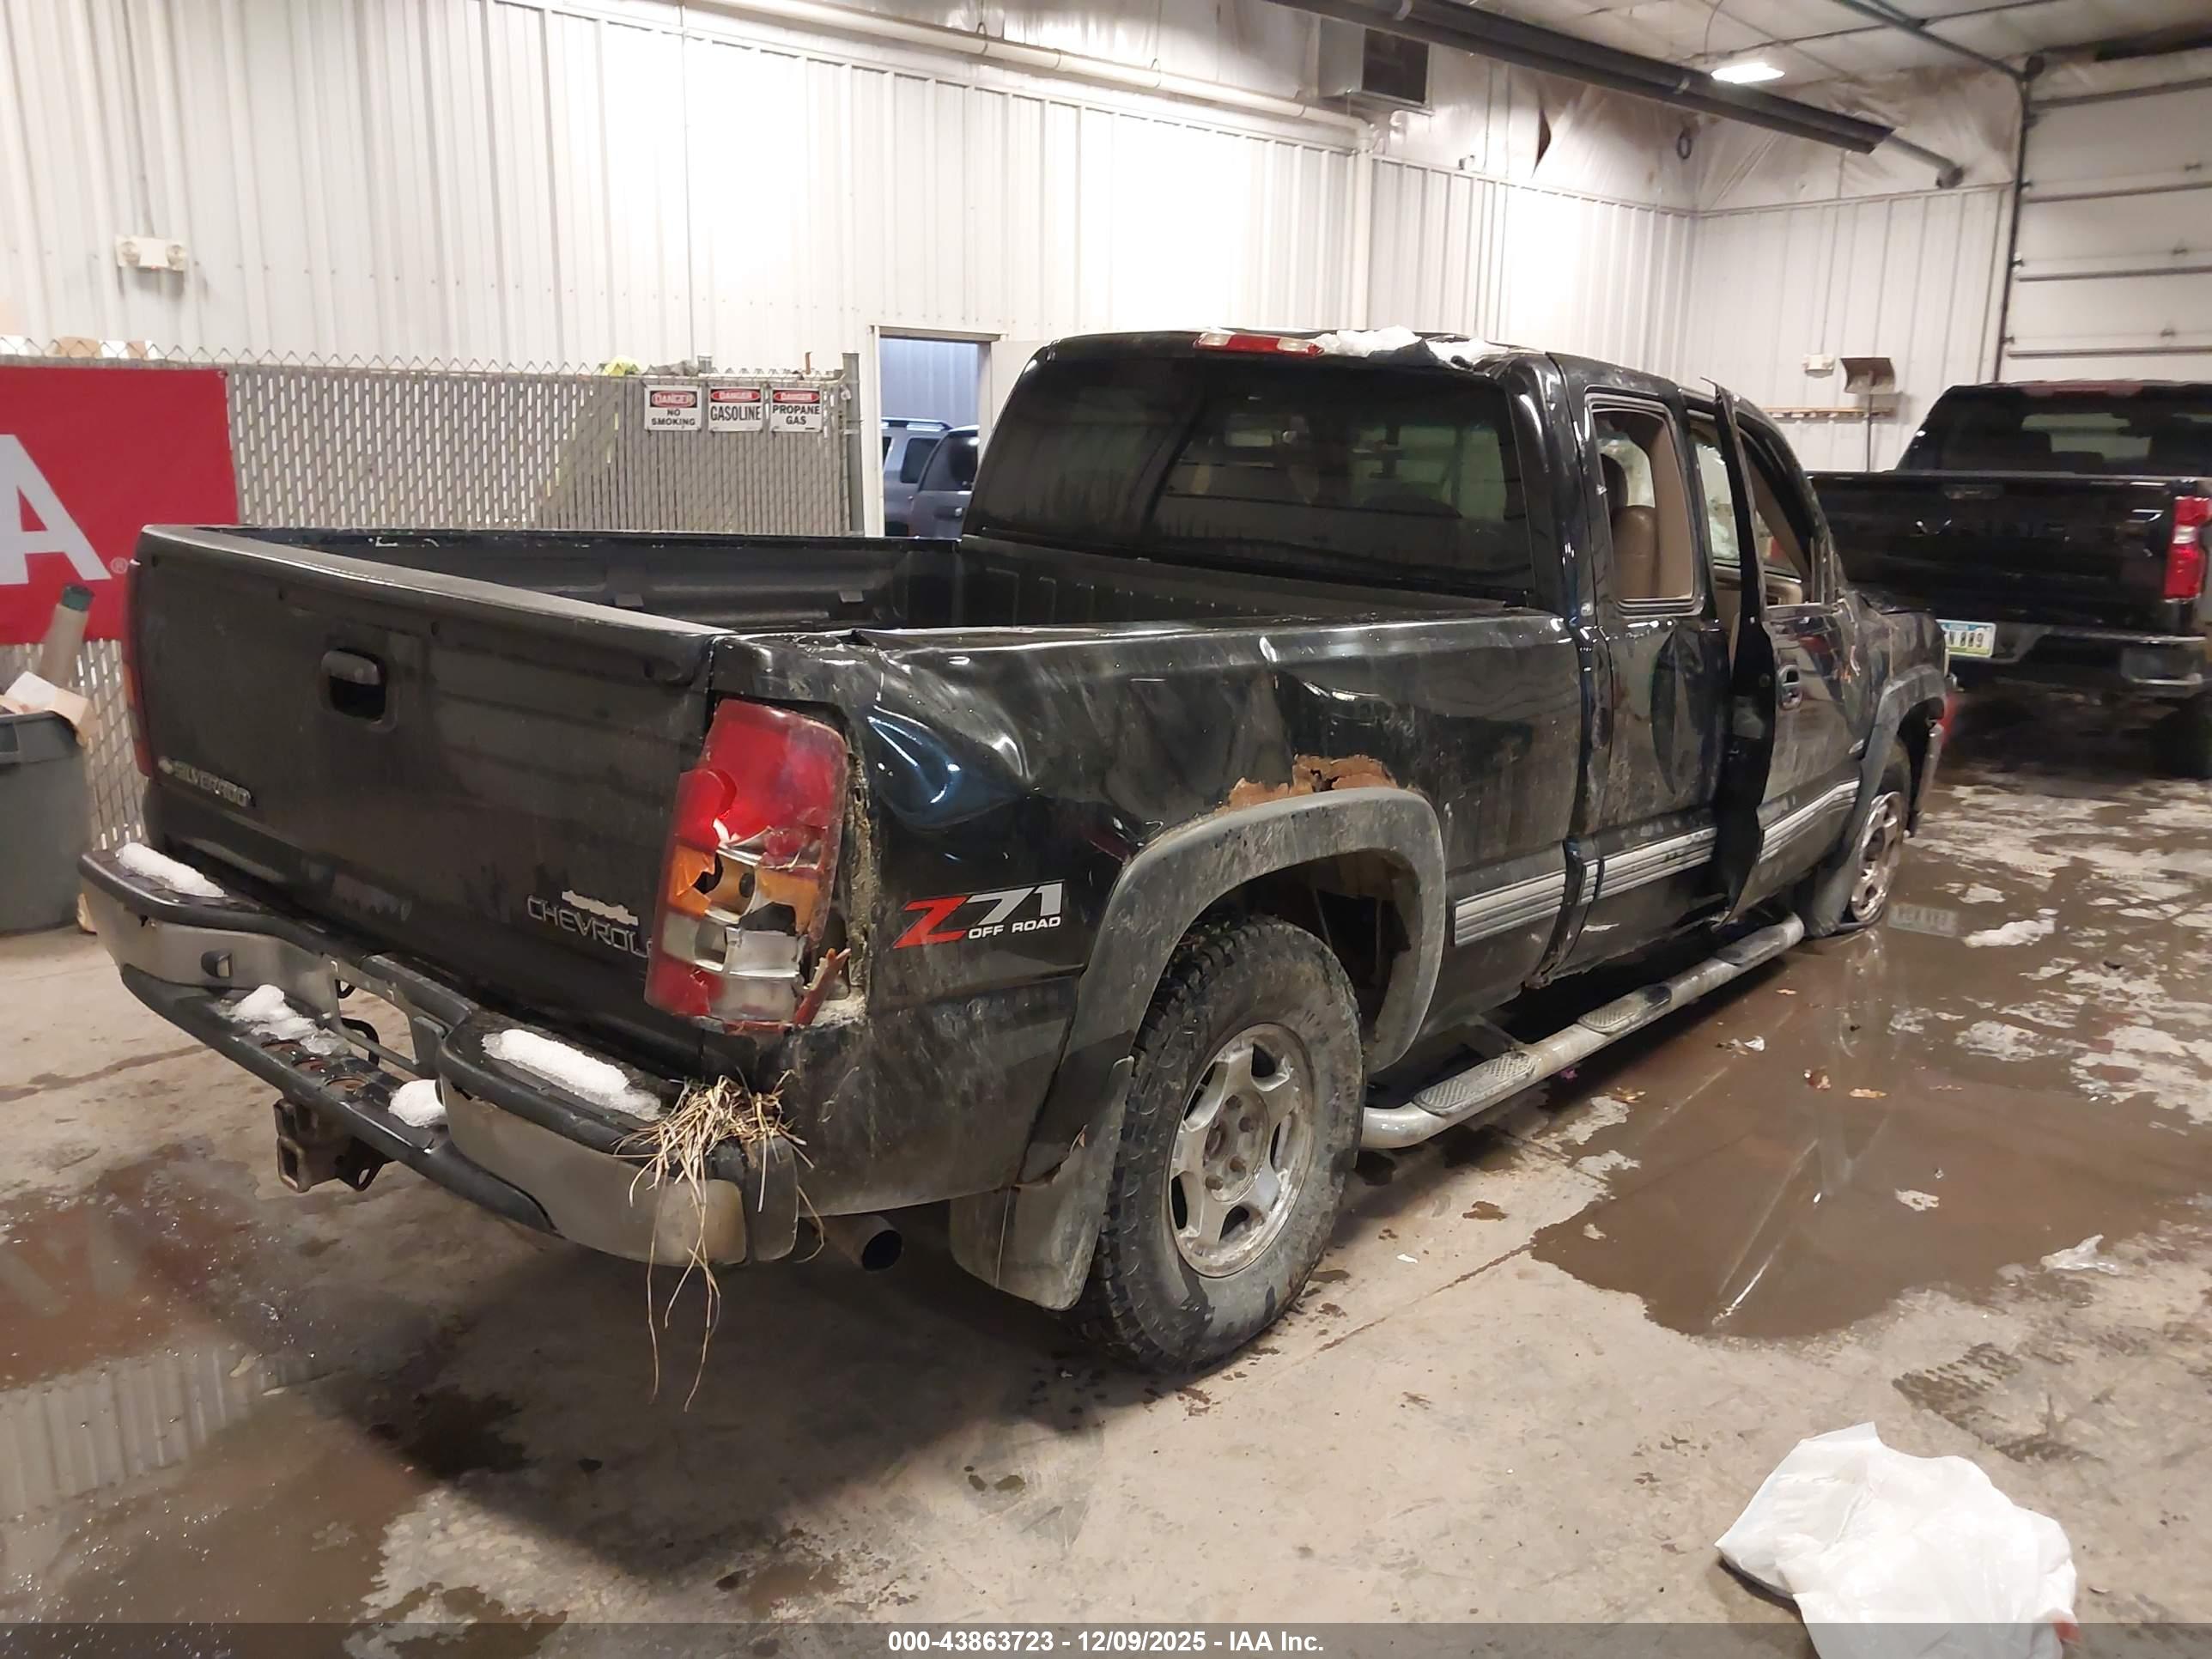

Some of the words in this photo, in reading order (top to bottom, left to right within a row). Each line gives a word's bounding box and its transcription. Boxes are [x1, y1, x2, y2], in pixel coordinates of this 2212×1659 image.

[710, 405, 762, 421] GASOLINE
[773, 404, 821, 415] PROPANE
[786, 416, 807, 425] GAS
[892, 882, 1064, 950] Z71
[968, 925, 1005, 939] OFF
[1012, 916, 1061, 933] ROAD
